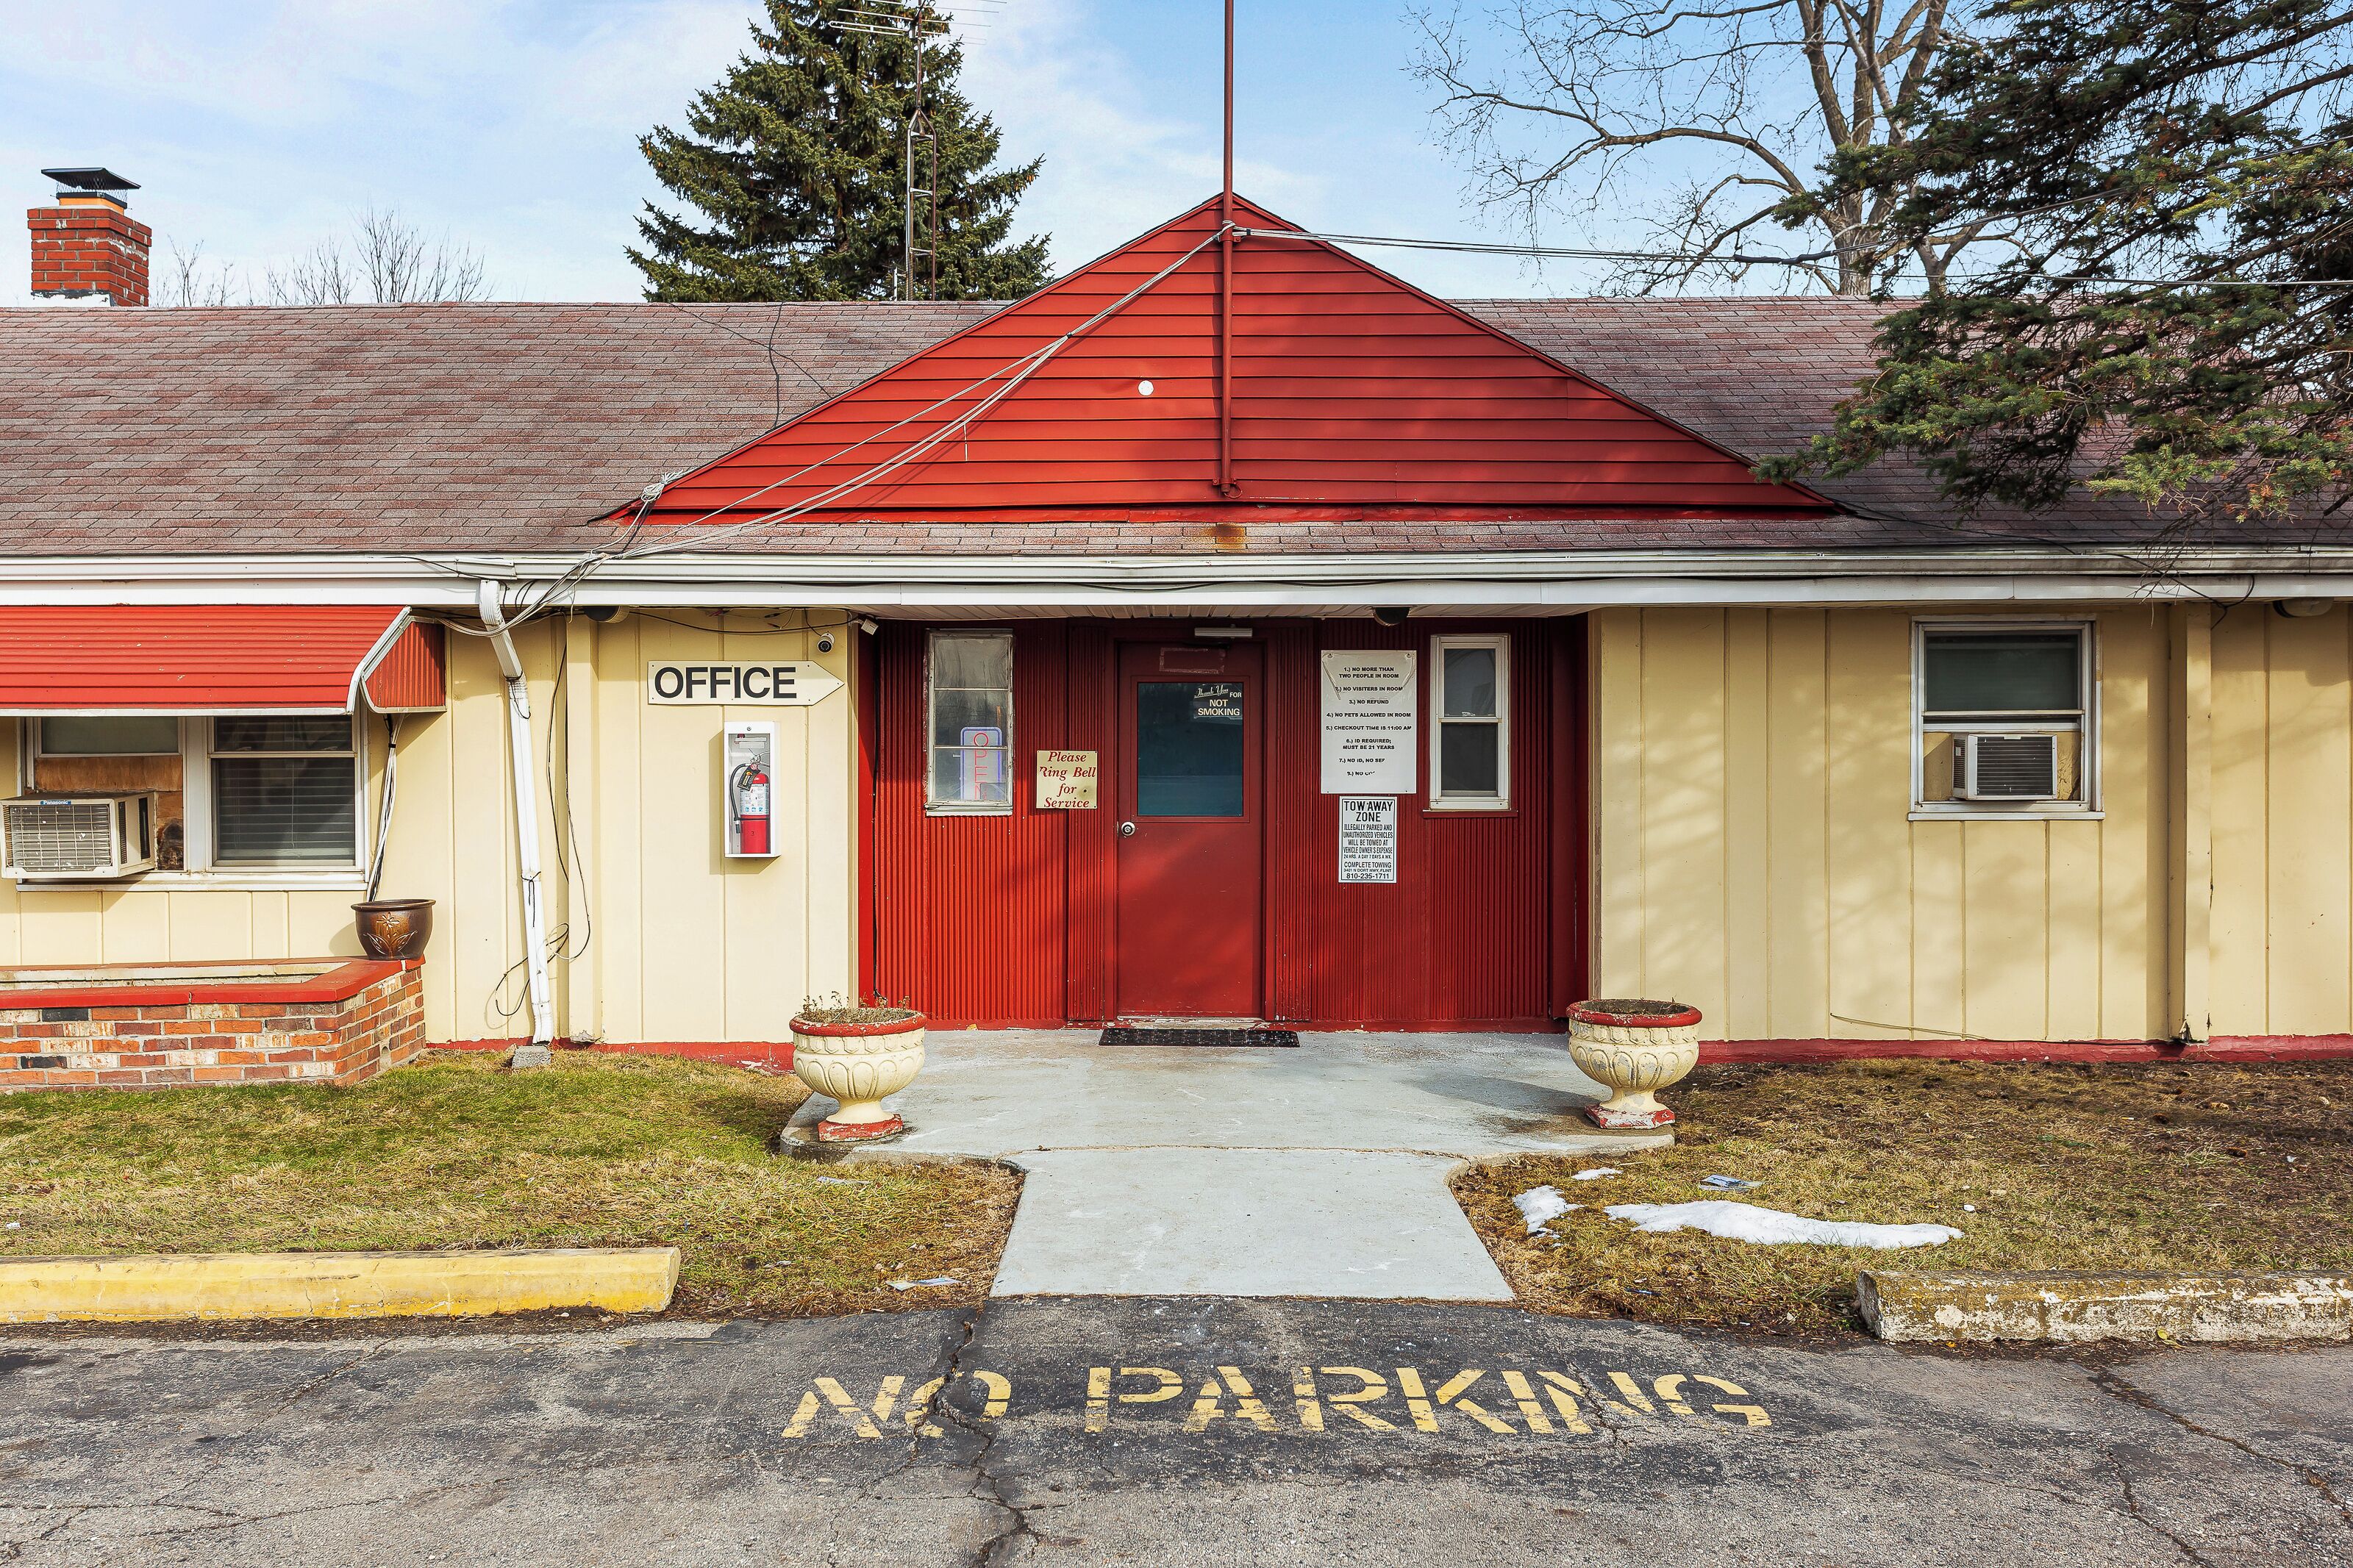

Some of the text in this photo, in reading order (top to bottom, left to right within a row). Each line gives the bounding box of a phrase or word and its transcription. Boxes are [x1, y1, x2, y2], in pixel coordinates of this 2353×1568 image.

[654, 667, 797, 699] OFFICE
[1197, 687, 1214, 696] Thank
[1215, 684, 1229, 696] You
[1210, 699, 1229, 707] NOT
[1198, 708, 1240, 716] SMOKING
[1047, 751, 1087, 762] Please
[974, 732, 989, 801] OPEN
[1039, 766, 1096, 781] Ring Bell
[1056, 783, 1077, 798] for
[1044, 797, 1090, 808] Service
[1344, 801, 1393, 812] TOW AWAY
[1356, 812, 1381, 822] ZONE
[780, 1365, 1773, 1439] NO PARKING
